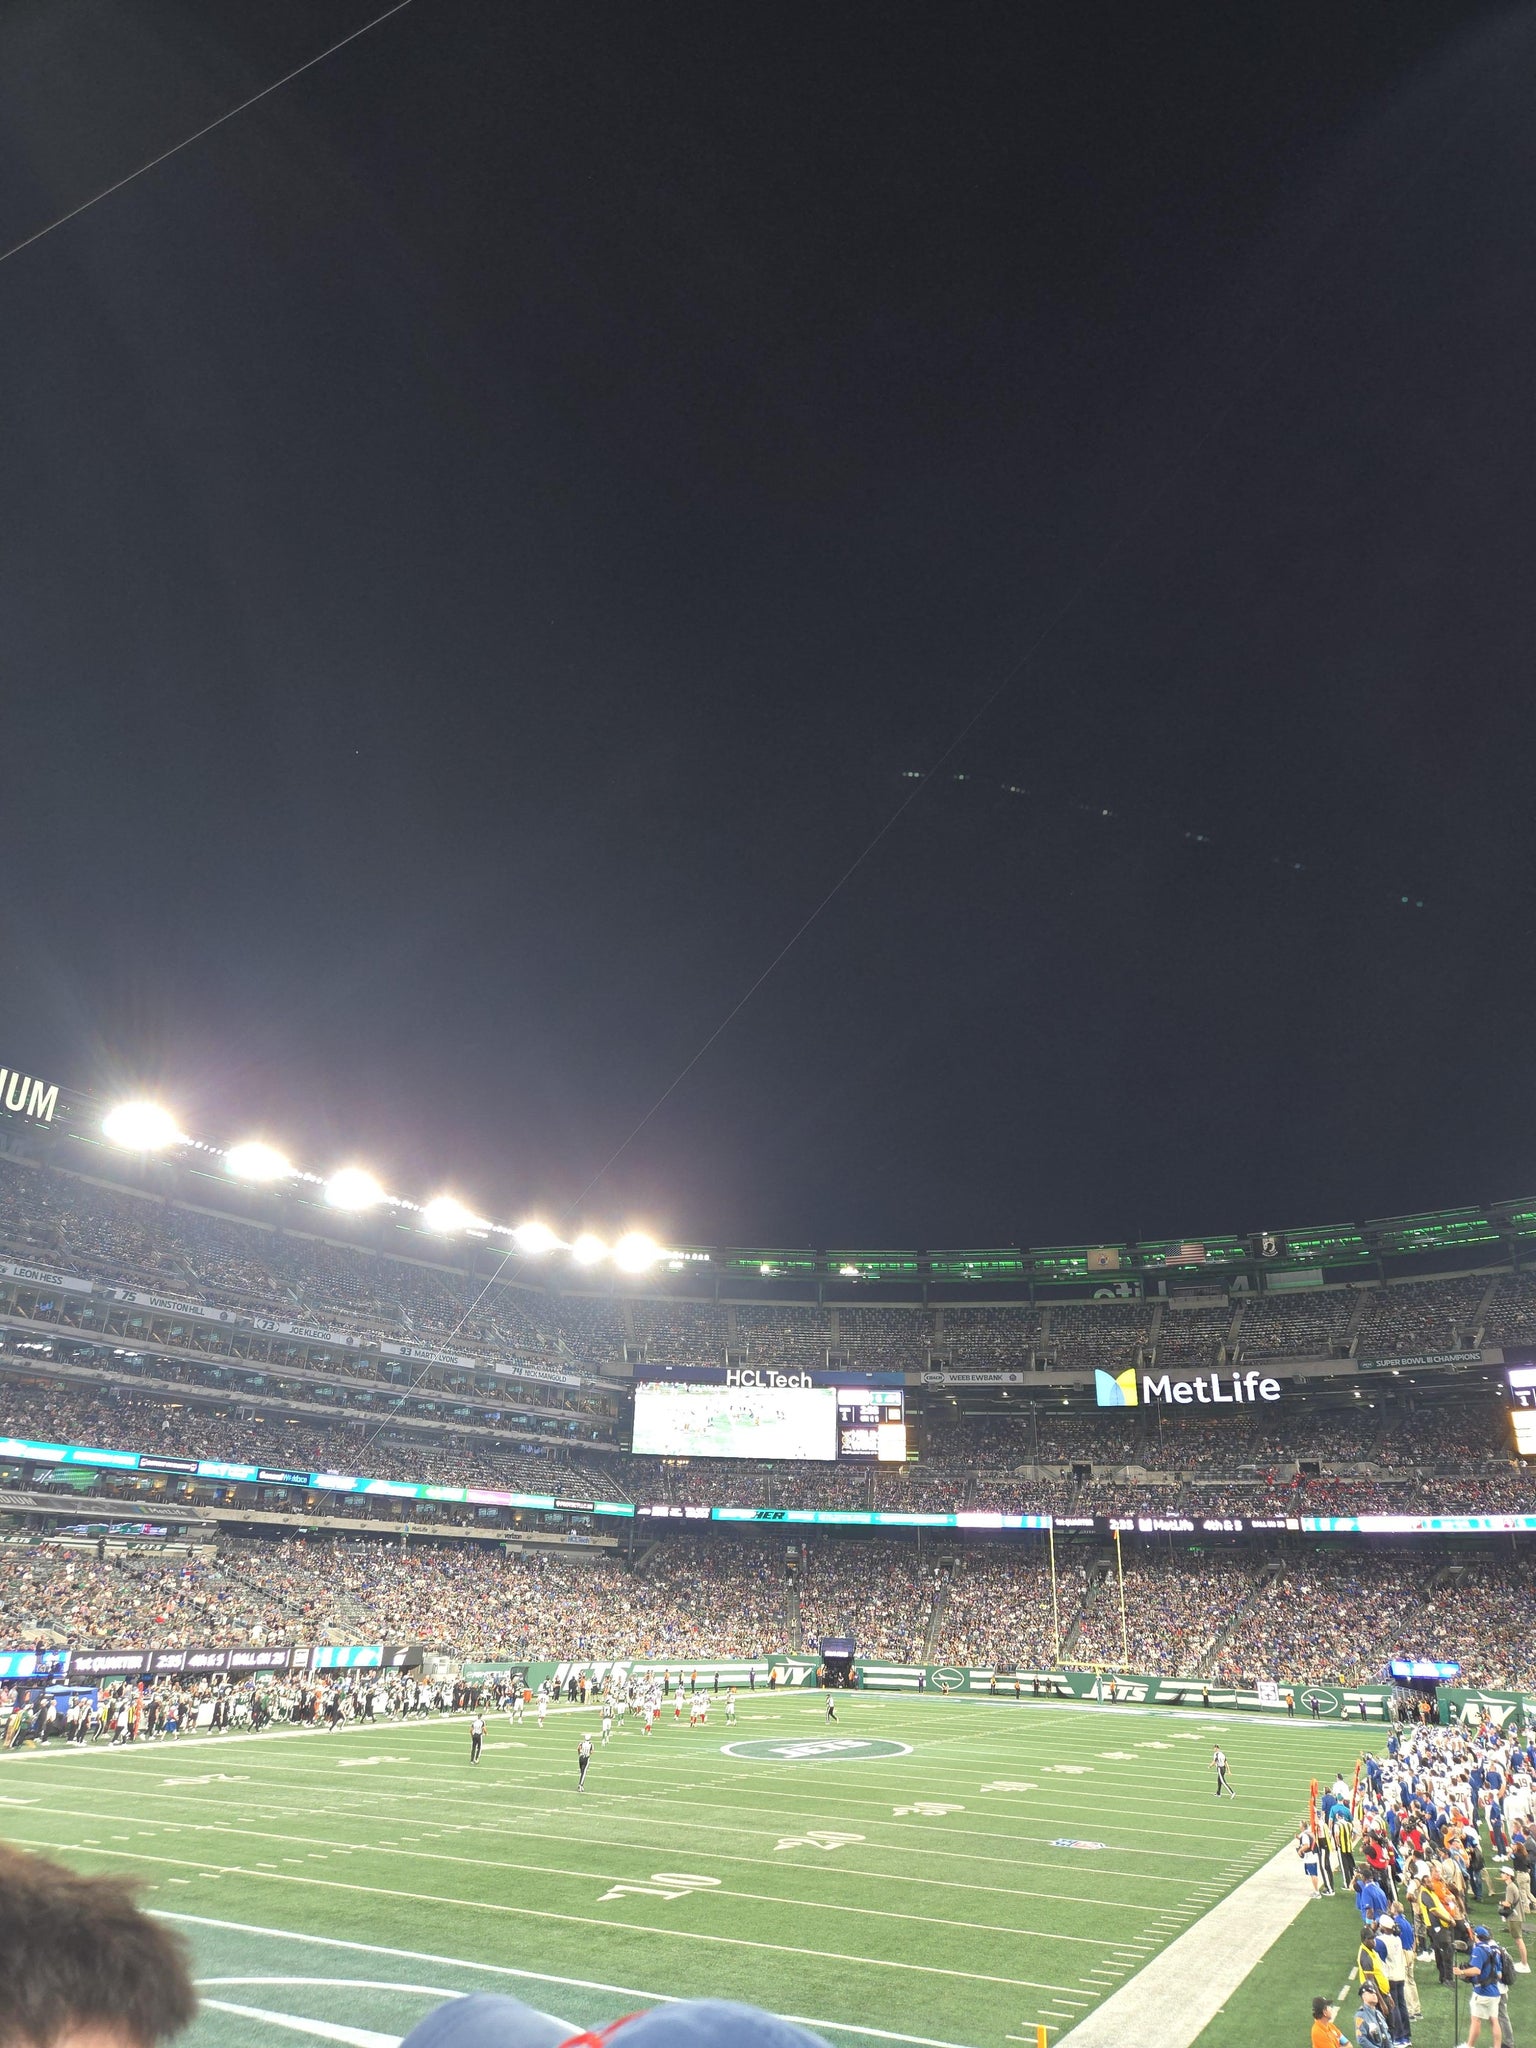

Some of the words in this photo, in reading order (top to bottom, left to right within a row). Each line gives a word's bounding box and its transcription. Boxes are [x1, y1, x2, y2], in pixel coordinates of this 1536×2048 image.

[13, 1267, 39, 1280] LEON
[40, 1273, 63, 1285] HESS
[121, 1290, 137, 1301] 75
[149, 1297, 188, 1313] WINSTON
[189, 1306, 205, 1316] HILL
[262, 1321, 274, 1330] 73
[289, 1326, 303, 1336] JOE
[303, 1329, 331, 1340] KLECKO
[400, 1346, 411, 1356] 93
[440, 1355, 458, 1364] LYONS
[1376, 1359, 1400, 1367] SUPER
[1401, 1357, 1426, 1365] BOWL
[1433, 1352, 1480, 1363] CHAMPIONS
[726, 1369, 813, 1389] HCLTech
[1143, 1371, 1281, 1404] MetLife
[148, 1506, 188, 1516] MetLife
[1153, 1518, 1194, 1532] MetLife
[1203, 1519, 1223, 1531] 4th
[132, 1543, 162, 1551] JETS
[92, 1655, 143, 1672] QUARTER
[231, 1653, 257, 1667] BALL
[767, 1666, 813, 1685] NY
[773, 1830, 867, 1851] 20
[597, 1872, 722, 1901] 10
